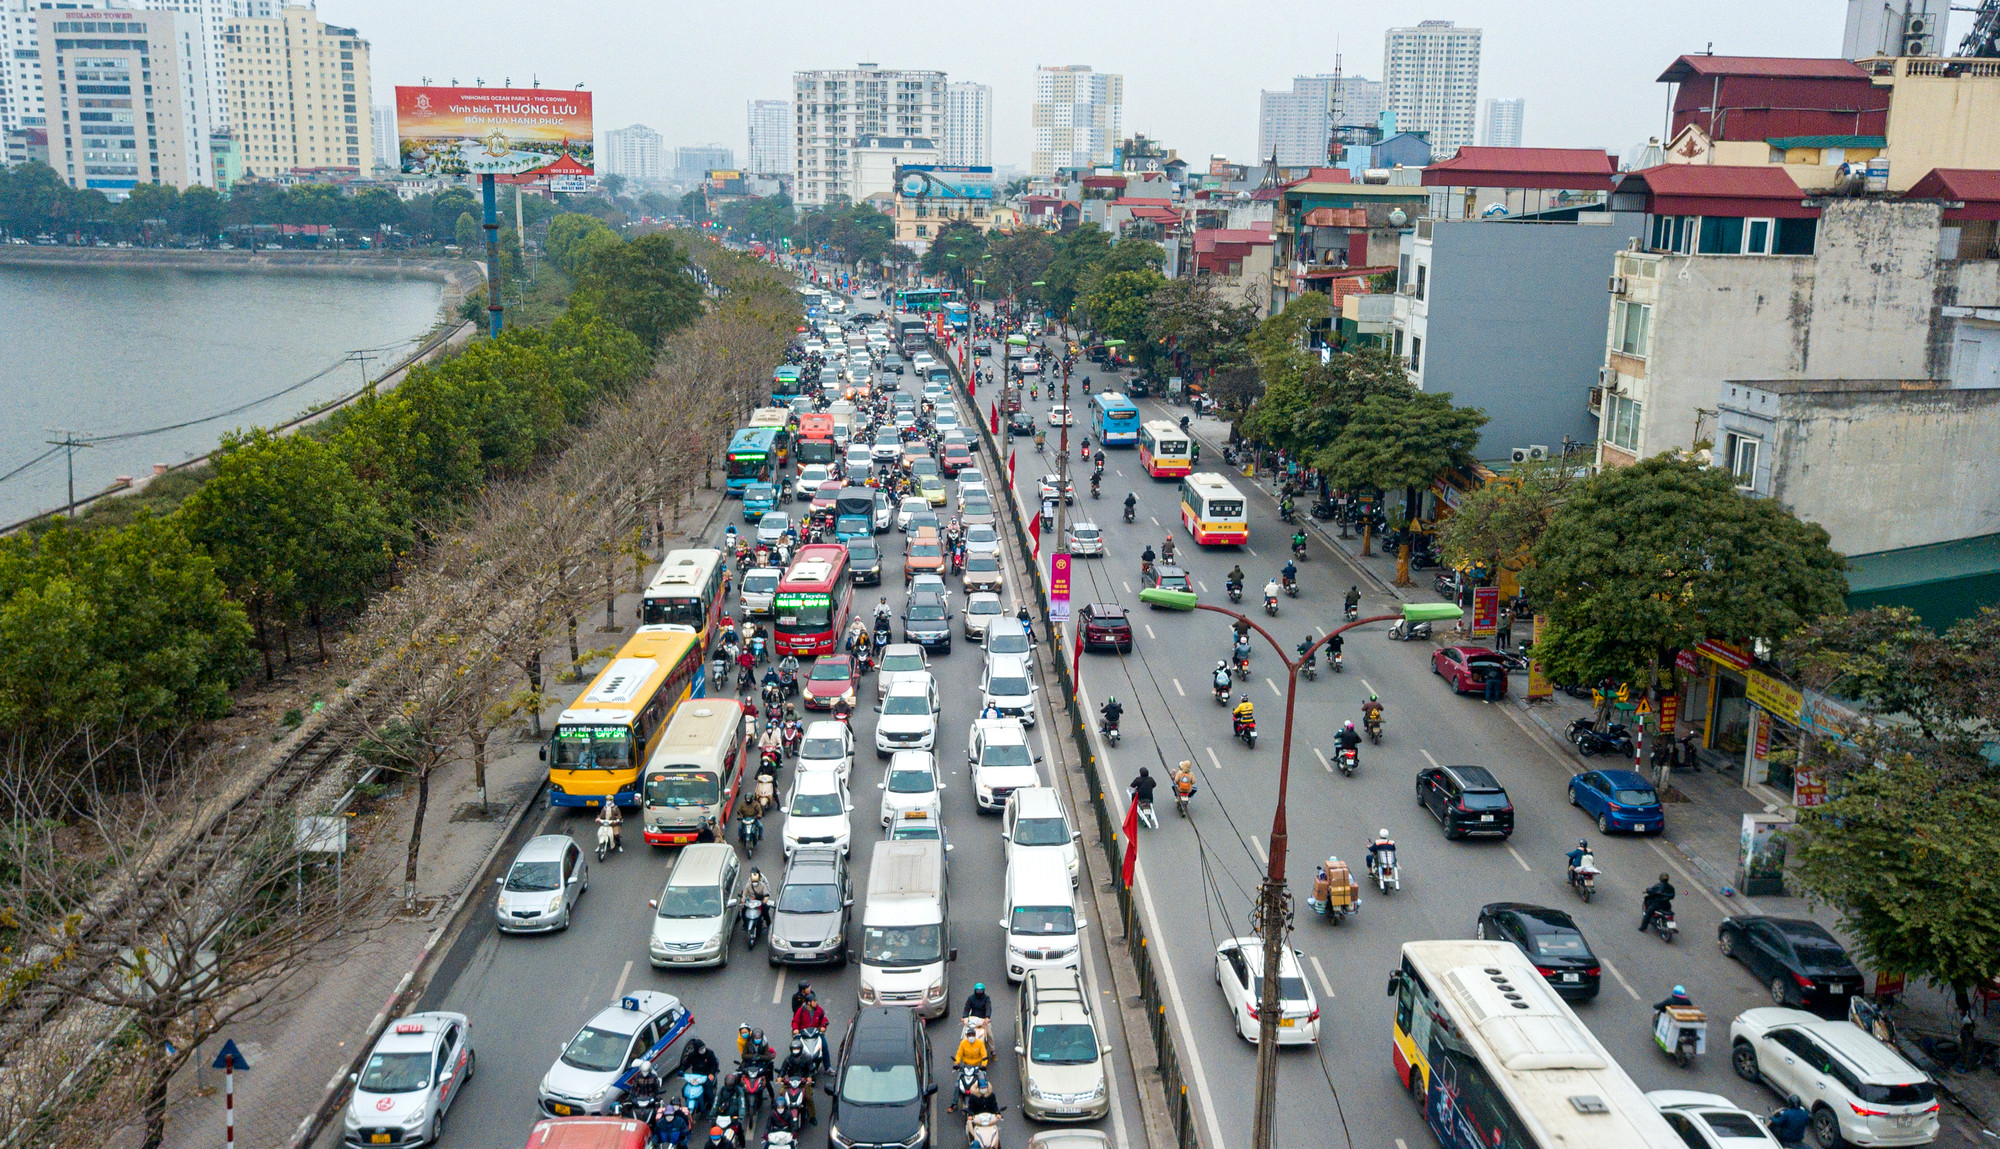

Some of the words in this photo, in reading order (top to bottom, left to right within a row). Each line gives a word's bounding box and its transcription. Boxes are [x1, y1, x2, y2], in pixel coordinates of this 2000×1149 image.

[494, 103, 549, 116] THƯỢNG
[552, 104, 578, 115] LƯU
[464, 115, 485, 124] BỐN
[487, 116, 509, 124] MÙA
[539, 116, 564, 125] PHÚC
